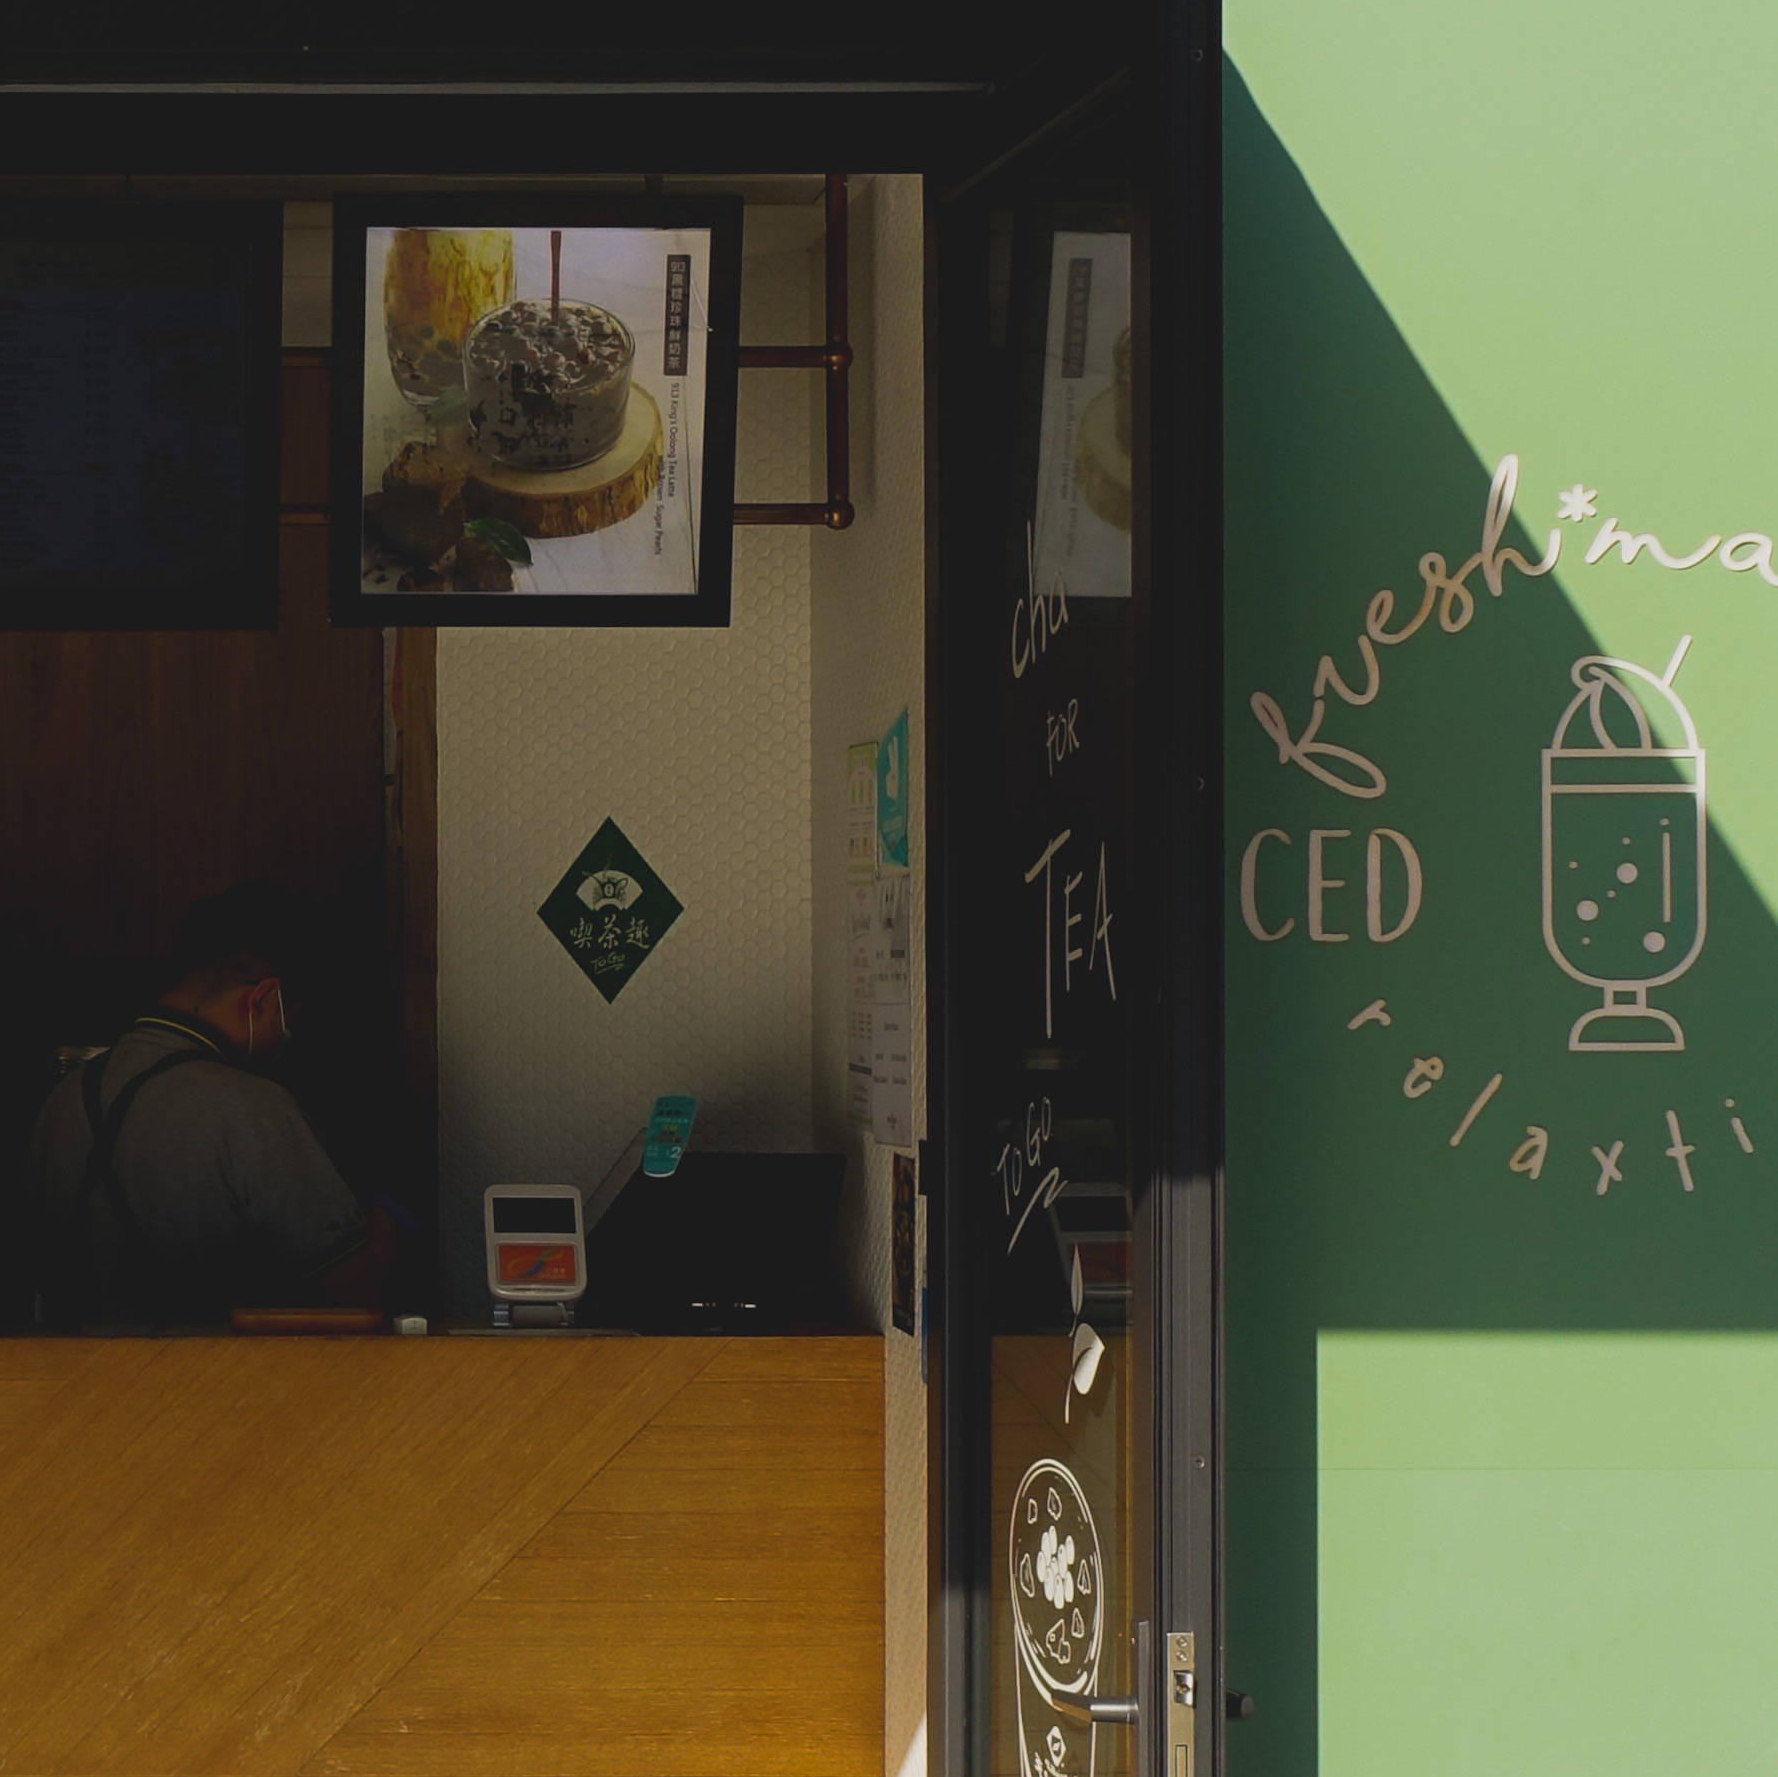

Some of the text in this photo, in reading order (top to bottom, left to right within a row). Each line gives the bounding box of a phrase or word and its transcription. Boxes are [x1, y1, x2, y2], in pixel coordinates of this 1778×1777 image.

[667, 383, 679, 497] 913 King's Oolong Tea Latte
[653, 504, 664, 529] Sugar
[654, 531, 663, 555] Pearls
[1012, 520, 1069, 679] cha
[1250, 454, 1562, 799] fresh
[1045, 697, 1080, 779] FOR
[1024, 828, 1117, 1040] TEA
